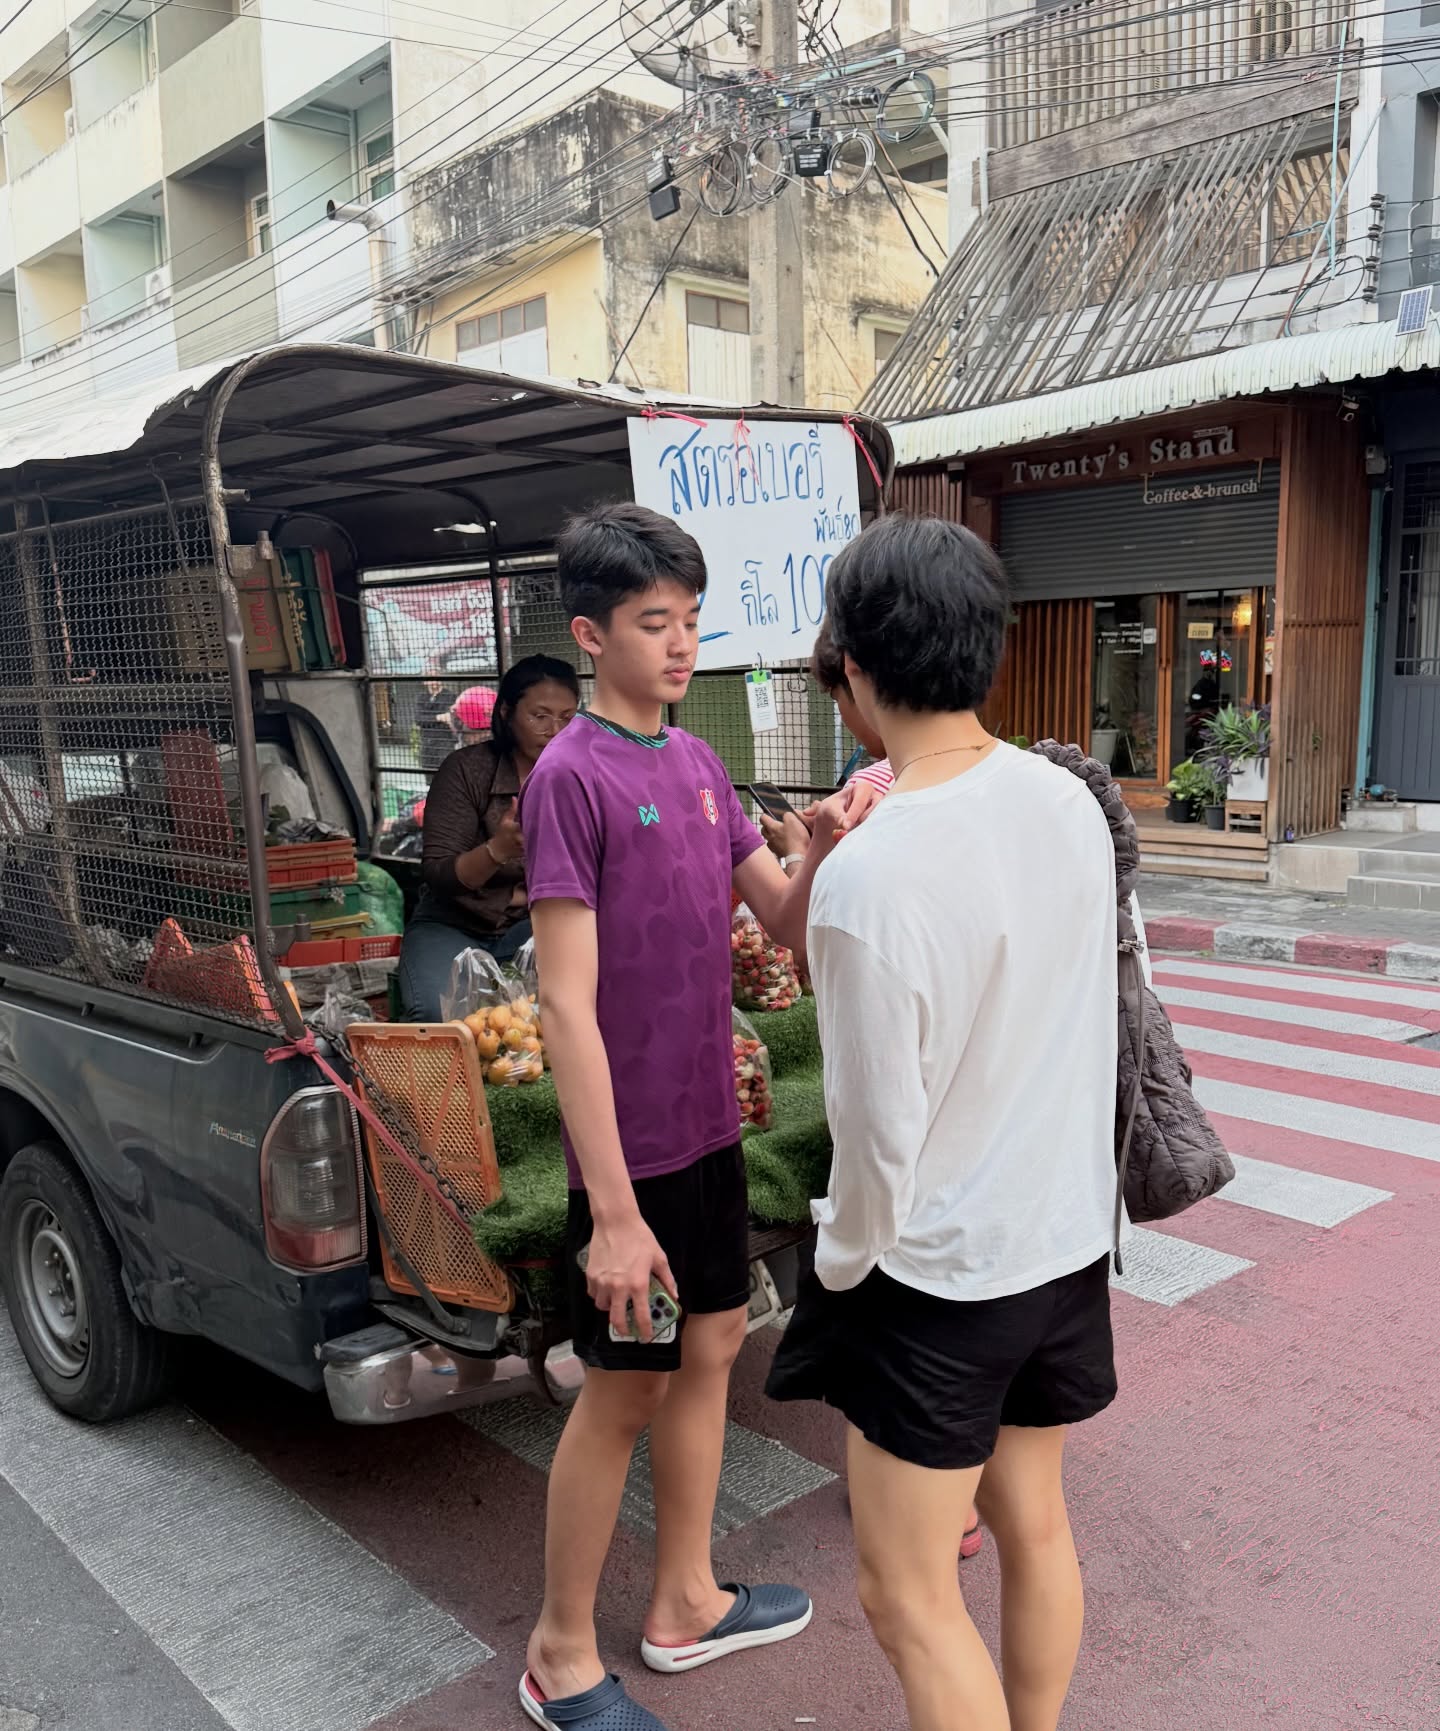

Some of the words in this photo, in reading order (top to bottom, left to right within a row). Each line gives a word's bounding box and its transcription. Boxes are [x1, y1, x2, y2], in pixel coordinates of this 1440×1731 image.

[1150, 429, 1236, 464] Stand
[1143, 487, 1189, 505] Coffee
[1207, 480, 1258, 498] brunch
